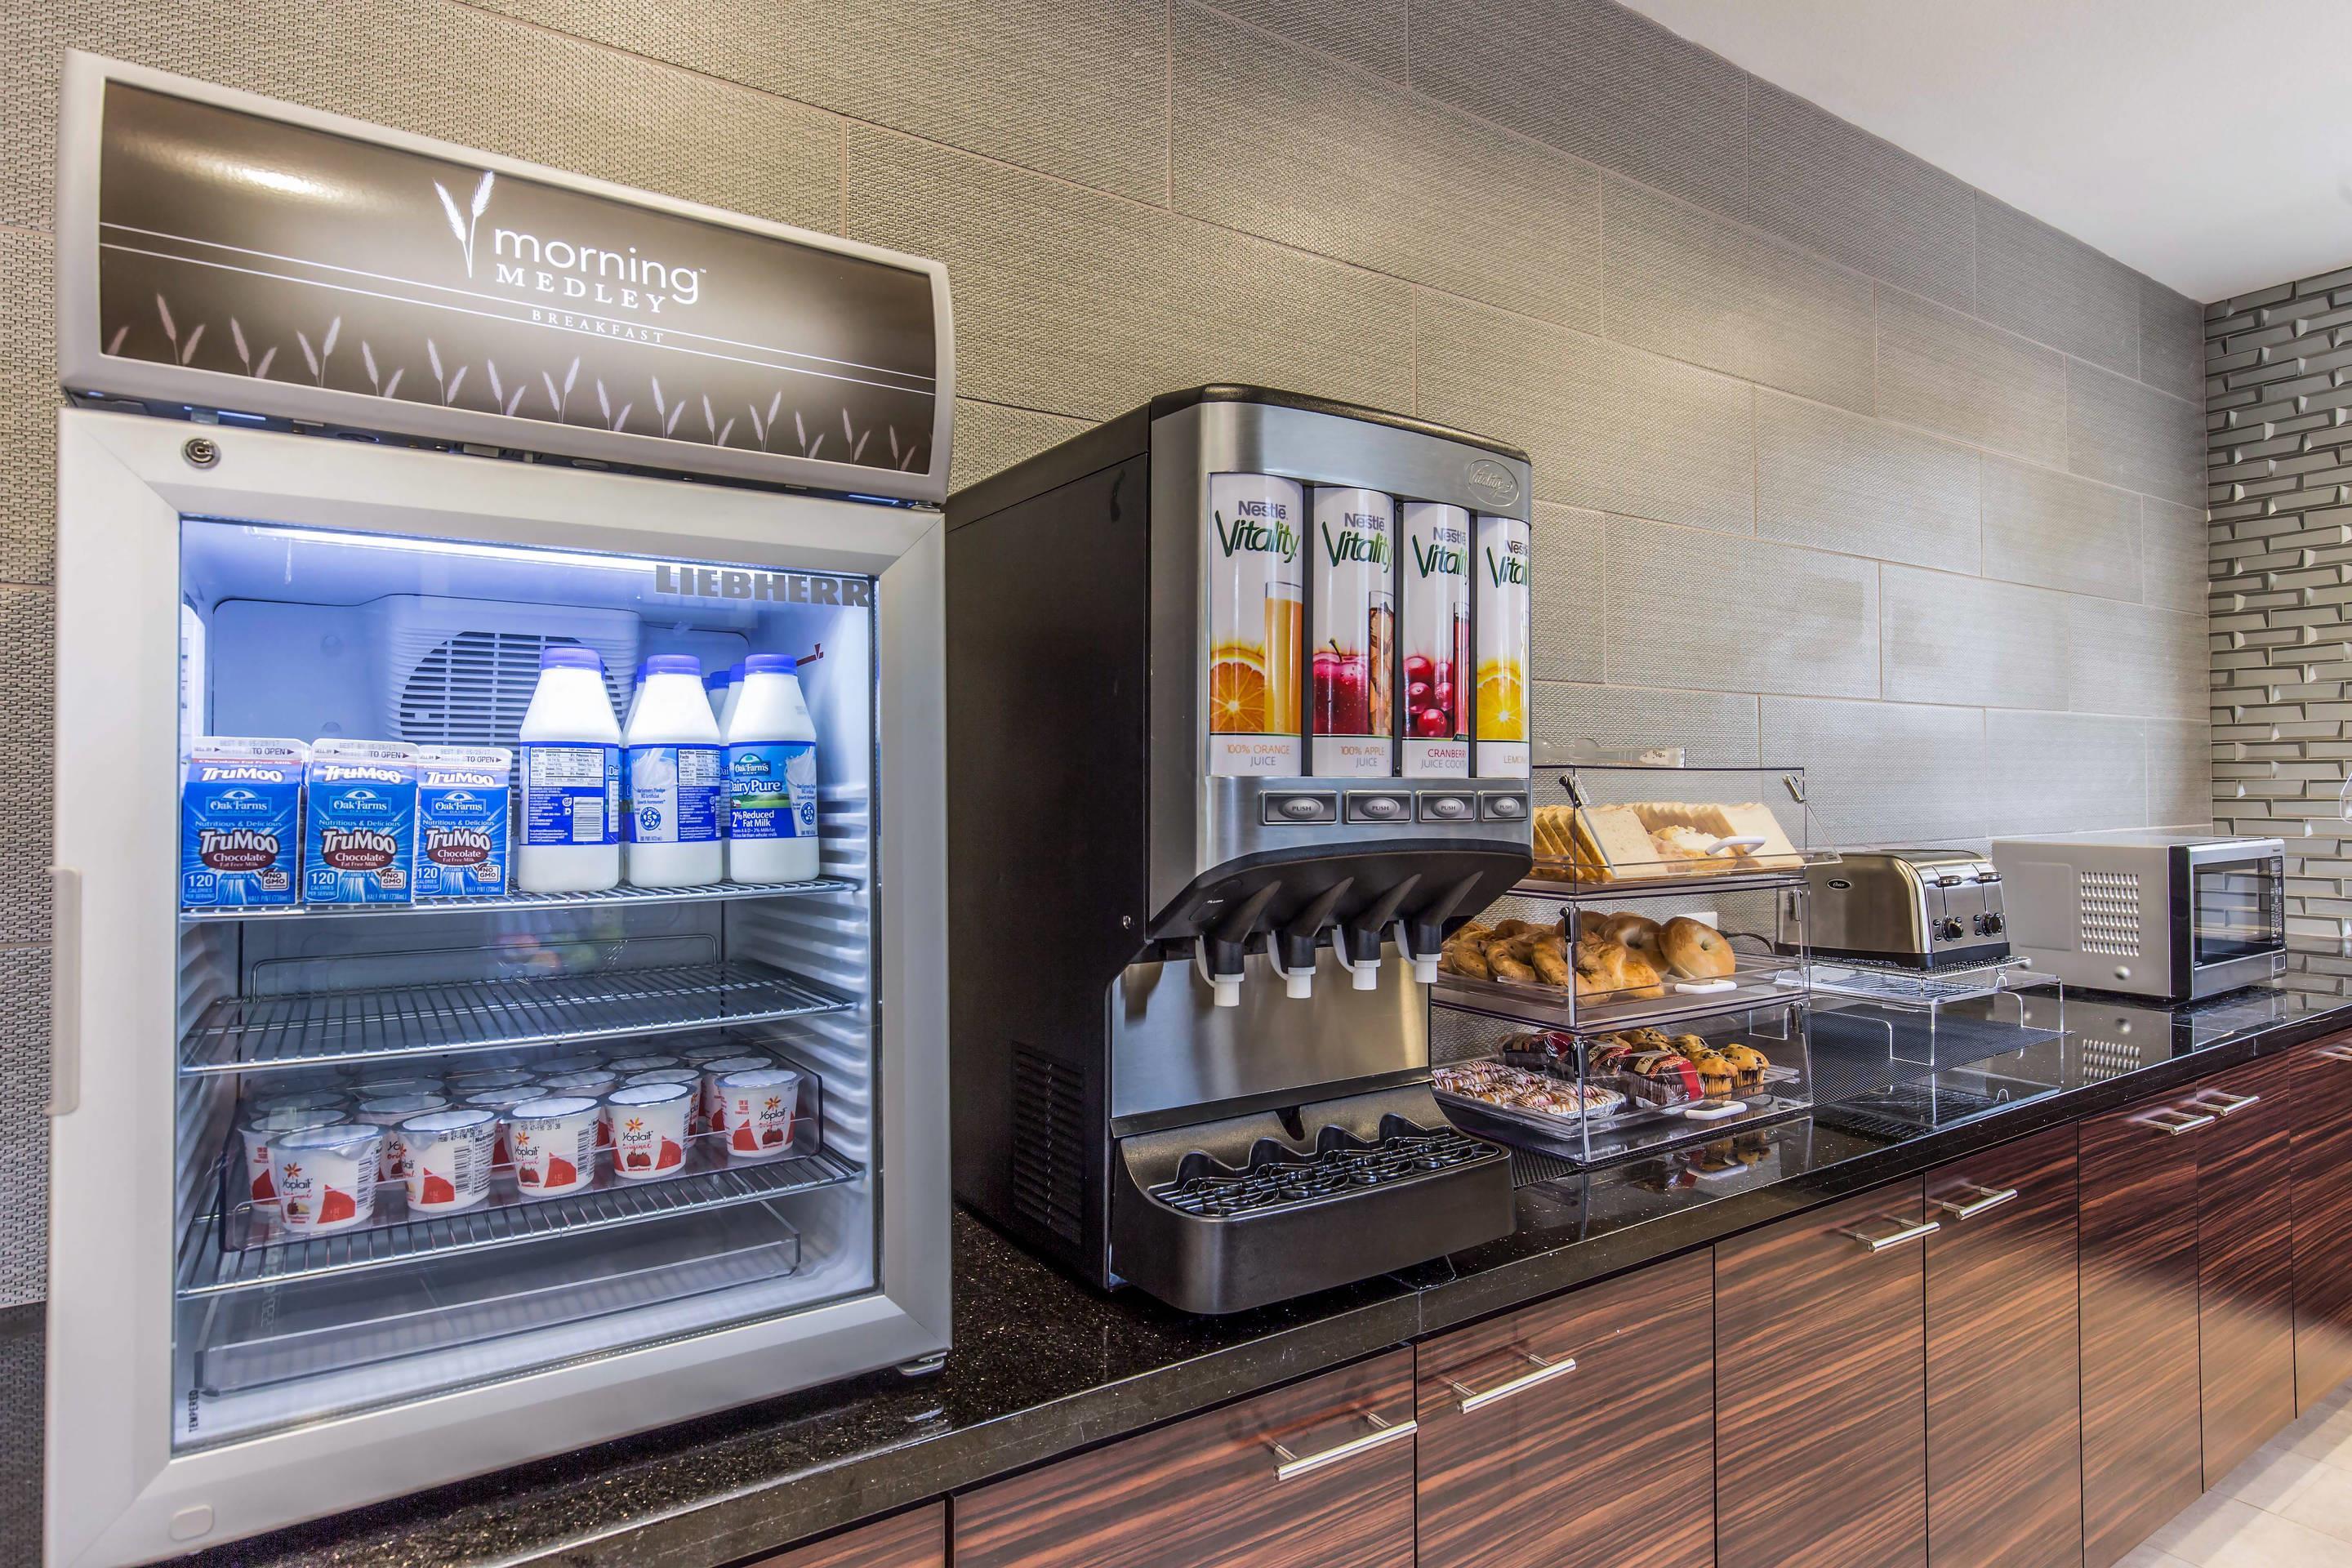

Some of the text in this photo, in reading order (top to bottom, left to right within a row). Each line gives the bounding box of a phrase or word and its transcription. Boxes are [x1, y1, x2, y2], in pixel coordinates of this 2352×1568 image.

[495, 228, 699, 305] morning
[496, 263, 666, 314] MEDLEY
[532, 309, 664, 343] BREAKFAST
[1214, 510, 1301, 564] Vitality
[1321, 521, 1393, 573] Vitality
[1486, 546, 1528, 588] Vital
[656, 564, 870, 608] LIEBHERR
[252, 747, 286, 755] TO OPEN
[1227, 744, 1290, 755] 100% ORANGE
[1340, 746, 1385, 756] 100% APPLE
[1250, 756, 1276, 767] JUICE
[1356, 757, 1378, 768] JUICE
[1420, 759, 1443, 769] JUICE
[202, 767, 283, 783] TruMoo
[325, 765, 402, 784] TruMoo
[426, 771, 495, 786] TruMoo
[210, 800, 268, 811] Oak Farms
[333, 800, 387, 811] Oak Farms
[435, 801, 483, 811] Oak Farms
[732, 811, 743, 828] 2%
[742, 809, 775, 819] Reduced
[742, 818, 772, 827] Fat Milk
[200, 831, 279, 855] TruMoo
[323, 830, 397, 855] TruMoo
[425, 829, 492, 851] TruMoo
[213, 853, 266, 862] Chocolate
[335, 853, 385, 862] Chocolate
[437, 849, 482, 858] Chocolate
[311, 872, 335, 884] 120
[417, 867, 438, 879] 120
[189, 875, 213, 887] 120
[759, 1107, 786, 1121] Yoplait
[622, 1130, 653, 1143] Yoplait
[514, 1146, 539, 1160] Yoplait
[282, 1178, 313, 1192] Yoplait
[188, 1389, 199, 1432] TEMPERED
